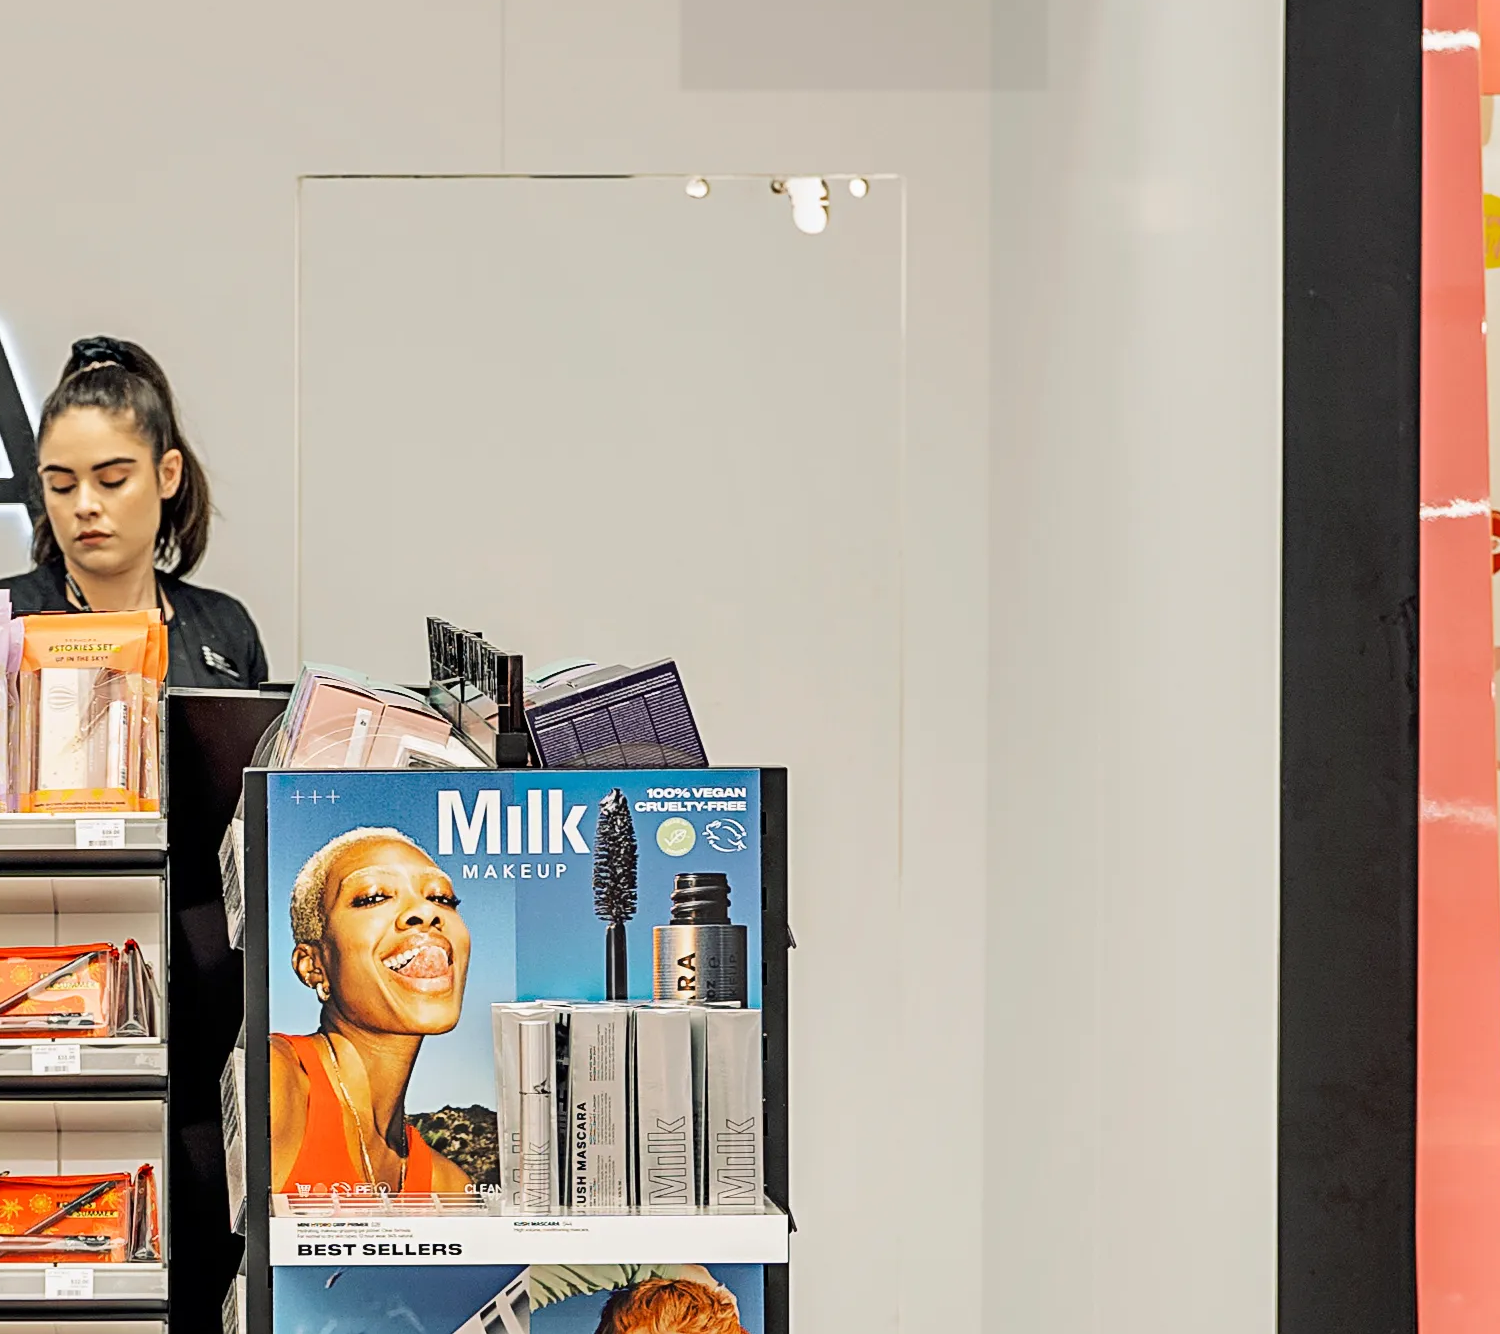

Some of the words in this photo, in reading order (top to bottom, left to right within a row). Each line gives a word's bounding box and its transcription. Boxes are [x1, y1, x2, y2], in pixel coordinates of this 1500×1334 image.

[48, 643, 97, 653] #STORIES
[99, 643, 115, 652] SET
[55, 655, 63, 663] UP
[646, 788, 691, 799] 100%
[693, 788, 747, 798] VEGAN
[634, 801, 747, 813] CRUELTY-FREE
[438, 789, 590, 855] Milk
[462, 863, 568, 879] MAKEUP
[577, 1101, 587, 1172] MASCARA
[647, 1116, 687, 1206] Milk
[716, 1116, 755, 1206] Milk
[522, 1140, 551, 1215] Milk
[75, 1209, 118, 1219] SUMMER
[297, 1243, 356, 1256] BEST
[362, 1243, 463, 1256] SELLERS
